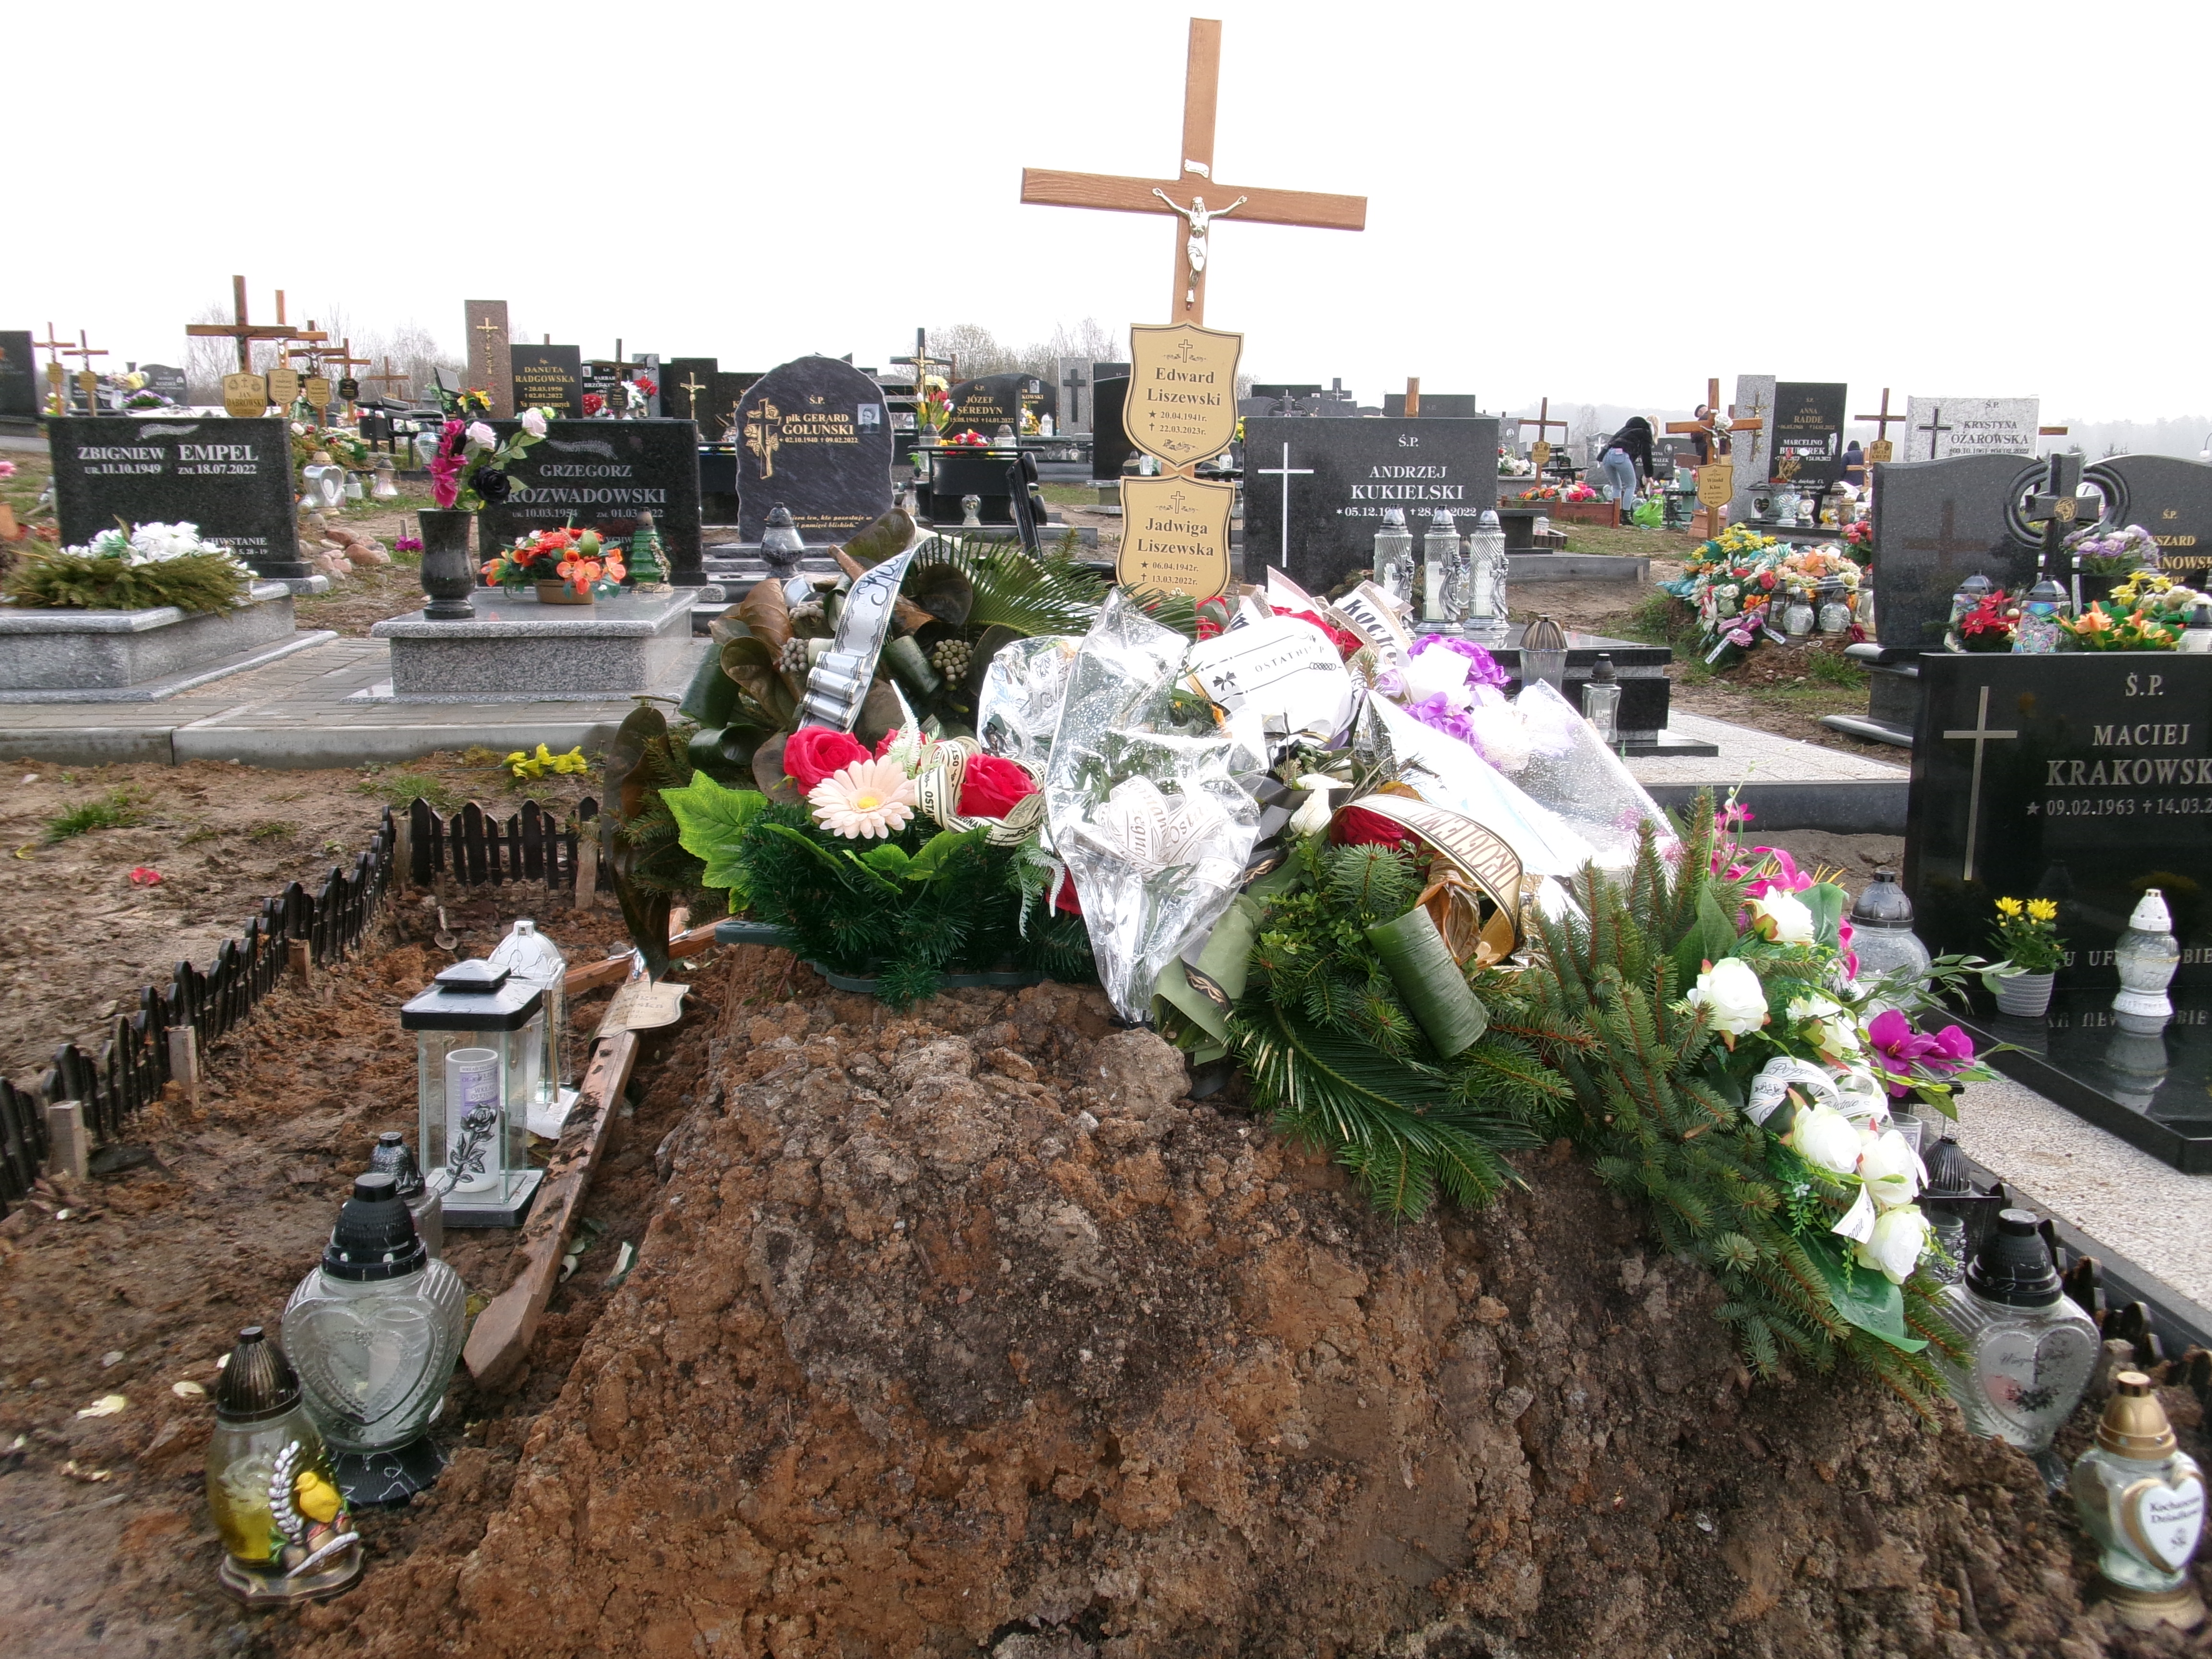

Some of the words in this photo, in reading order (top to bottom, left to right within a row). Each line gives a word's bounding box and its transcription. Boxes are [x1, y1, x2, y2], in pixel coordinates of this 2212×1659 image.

[1155, 367, 1214, 384] Edward
[809, 395, 825, 404] Ś.P.
[966, 394, 994, 404] JÓZEF
[1147, 388, 1221, 406] Liszewski
[803, 414, 849, 422] GERARD
[1160, 411, 1207, 422] 20.04.1941r.
[1159, 425, 1206, 435] 22.03.2023r.
[1964, 421, 2018, 430] KRYSTYNA
[1398, 434, 1419, 447] Ś.P.
[1951, 432, 2029, 444] OŻAROWSKA
[77, 446, 165, 460] ZBIGNIEW
[178, 444, 259, 461] EMPEL
[101, 464, 161, 474] 11.10.1949
[197, 464, 257, 474] 18.07.2022
[540, 464, 632, 477] GRZEGORZ
[1369, 466, 1447, 479] ANDRZEJ
[507, 488, 666, 504] ROZWADOWSKI
[1350, 484, 1464, 500] KUKIELSKI
[1418, 507, 1477, 517] 28..2022
[2163, 509, 2177, 519] Ś.P.
[1145, 517, 1208, 537] Jadwiga
[1137, 538, 1214, 556] Liszewska
[2148, 535, 2196, 546] YSZARD
[1152, 562, 1199, 572] 06.04.1942r.
[1152, 575, 1198, 585] 13.03.2022r.
[1255, 646, 1311, 672] OSTATNI
[2092, 724, 2190, 746] MACIEJ
[2045, 758, 2212, 786] KRAKOWSK
[2047, 799, 2135, 816] 09.02.1963
